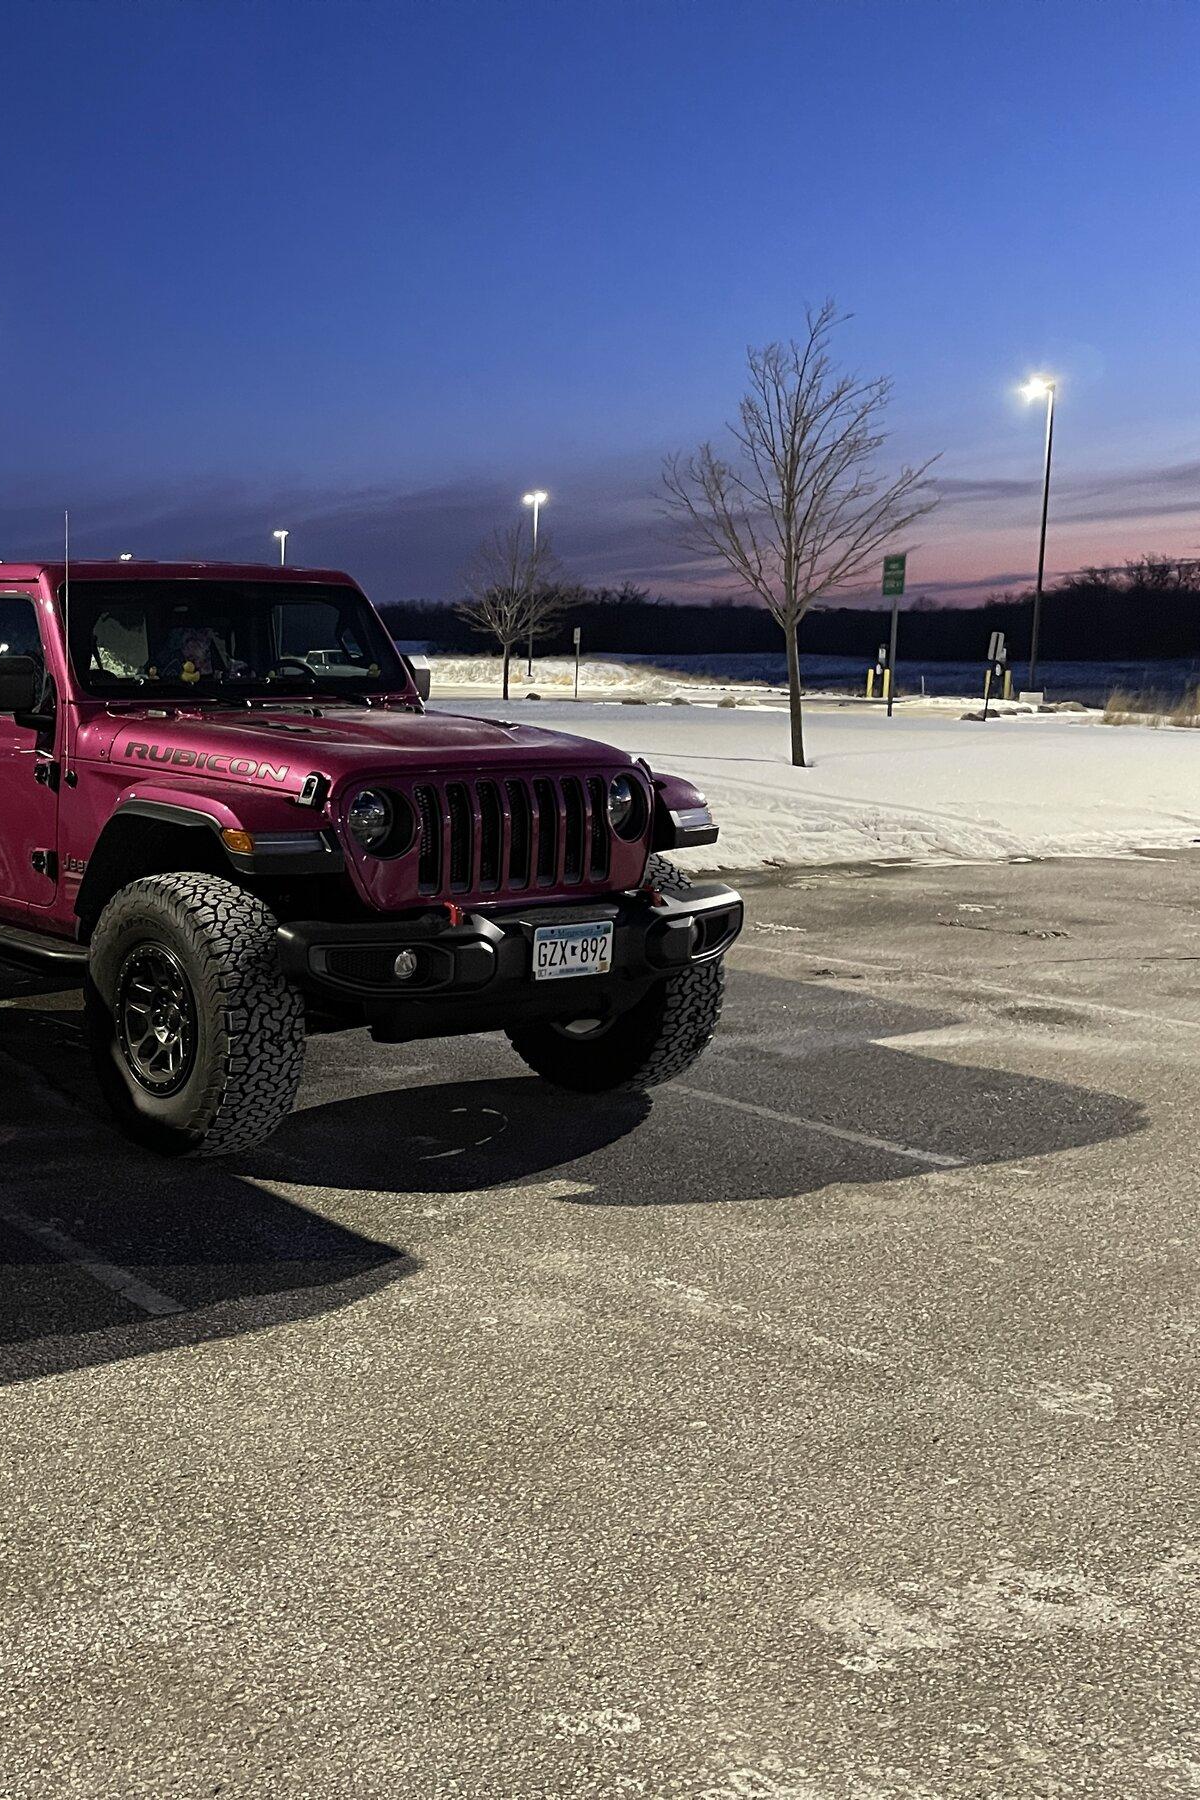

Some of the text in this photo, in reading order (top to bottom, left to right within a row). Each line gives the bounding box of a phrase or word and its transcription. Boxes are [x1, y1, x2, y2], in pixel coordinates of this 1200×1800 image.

[125, 741, 290, 782] RUBICON
[538, 936, 607, 967] GZX 892
